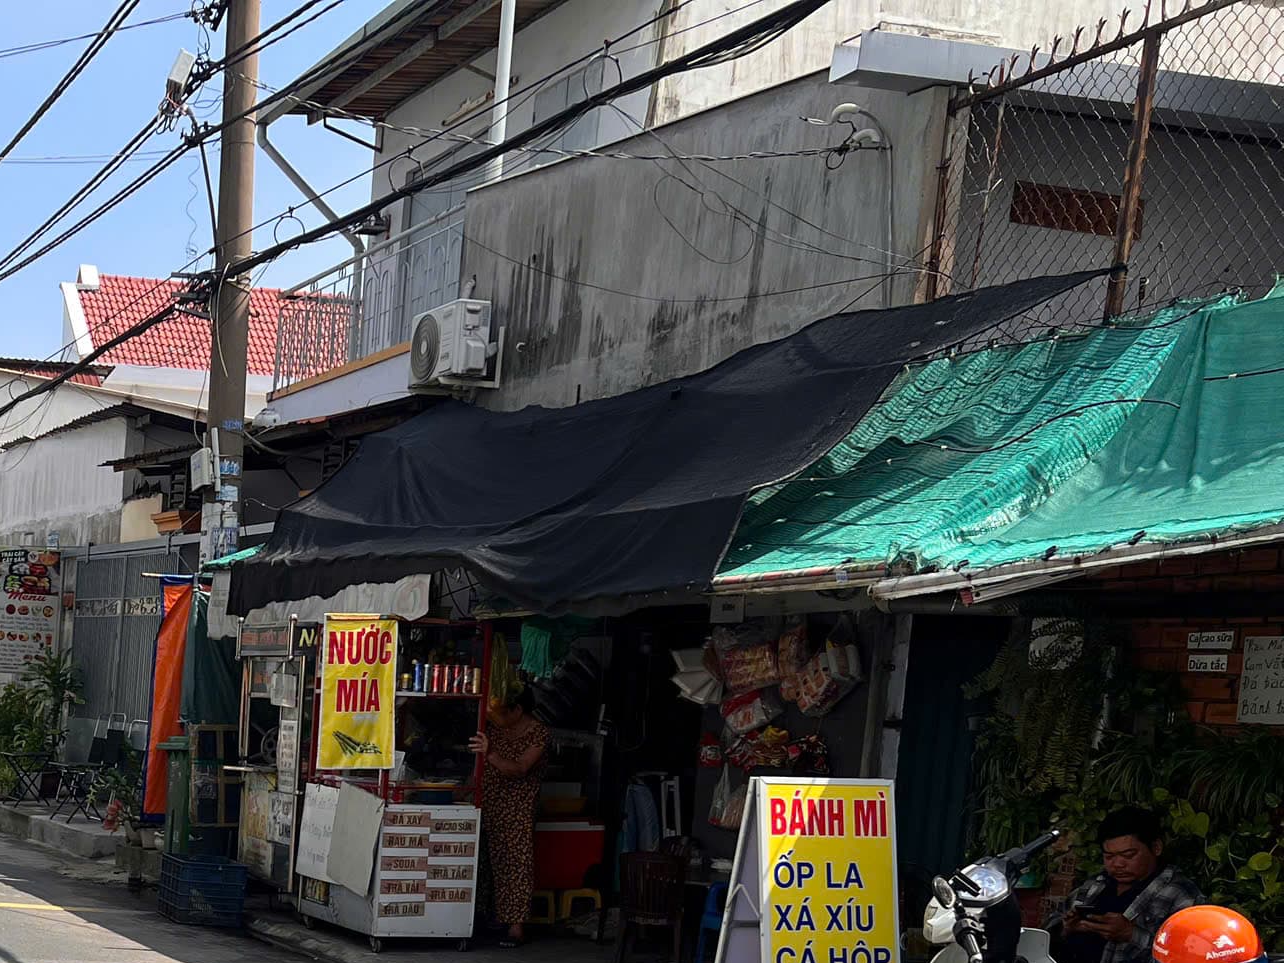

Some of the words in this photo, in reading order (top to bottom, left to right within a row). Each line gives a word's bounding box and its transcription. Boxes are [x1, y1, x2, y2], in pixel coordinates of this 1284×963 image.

[328, 624, 393, 665] NƯỚC
[336, 672, 380, 712] MÍA
[770, 790, 845, 836] BÁNH
[854, 791, 888, 837] MÌ
[388, 835, 406, 847] RAU
[774, 850, 814, 889] ỐP
[826, 862, 864, 889] LA
[774, 897, 815, 931] XÁ
[825, 897, 874, 932] XÍU
[1206, 946, 1246, 960] Ahamove
